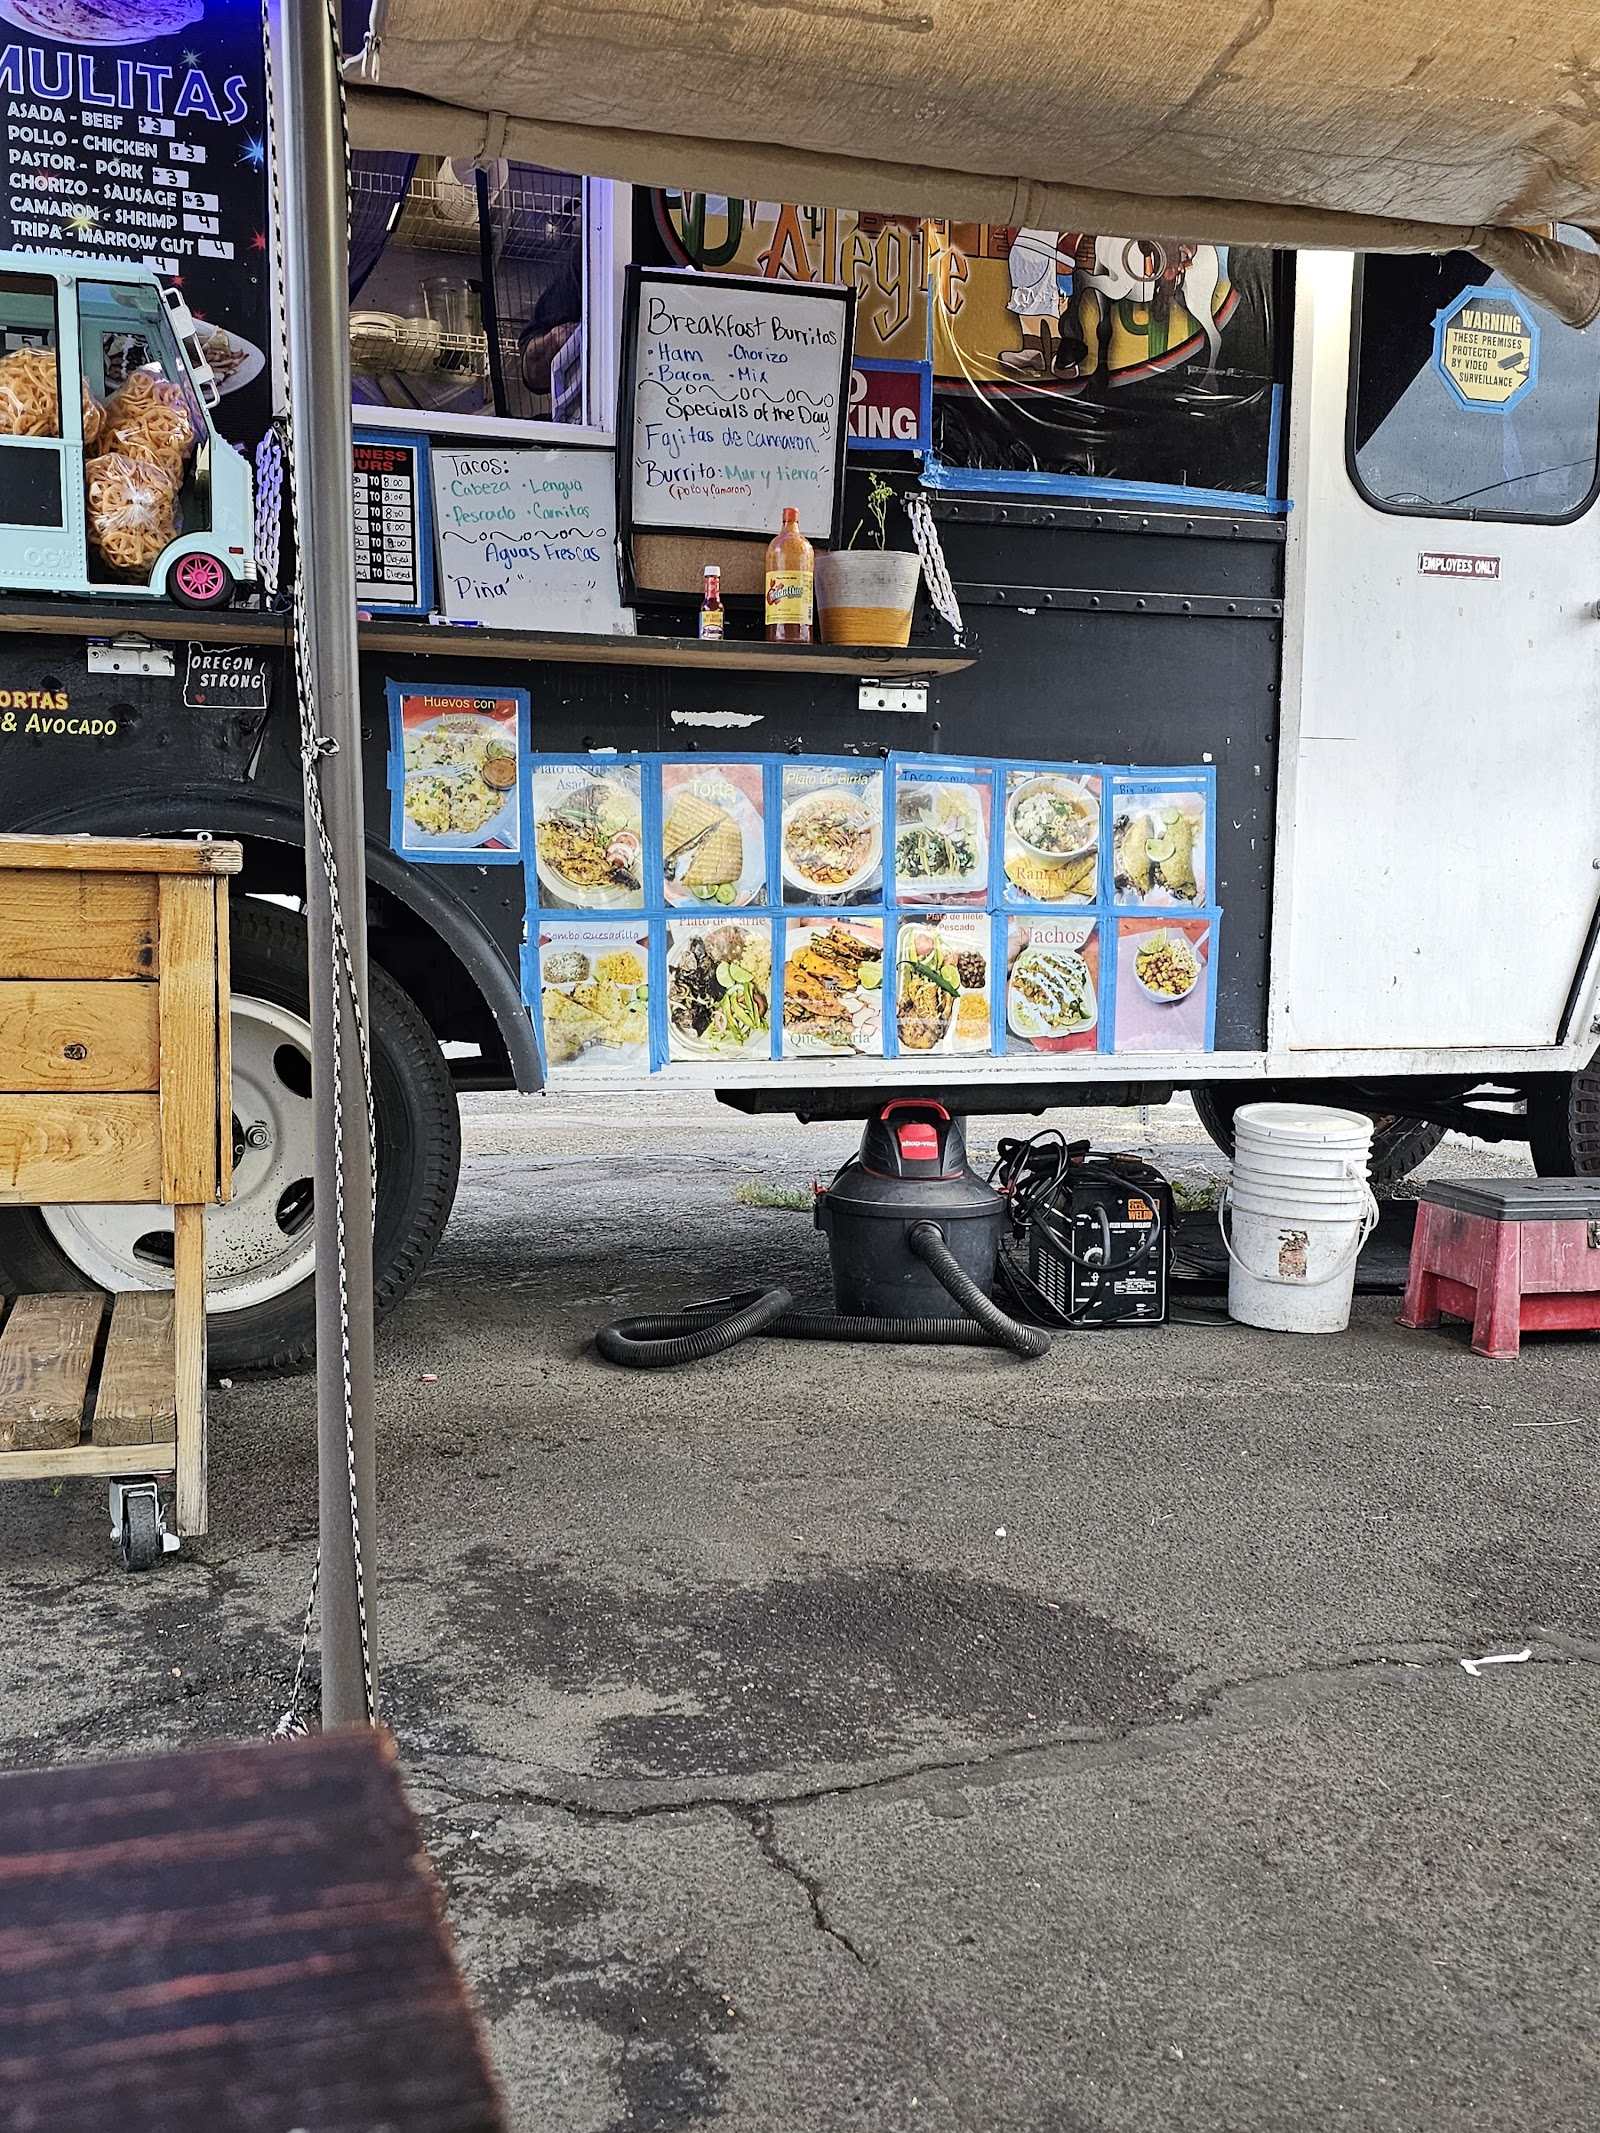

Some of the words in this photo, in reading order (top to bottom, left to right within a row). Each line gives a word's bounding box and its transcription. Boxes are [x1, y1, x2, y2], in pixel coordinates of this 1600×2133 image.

[8, 101, 66, 123] ASADA
[81, 110, 123, 130] BEEF
[8, 124, 67, 147] POLLO
[83, 134, 158, 158] CHICKEN
[9, 148, 76, 172] PASTOR
[96, 159, 144, 180] PORK
[9, 172, 88, 197] CHORIZO
[104, 183, 177, 207] SAUSAGE
[10, 196, 99, 221] CAMARON
[115, 208, 178, 229] SHRIMP
[11, 219, 62, 240] TRIPA
[78, 227, 158, 250] MARROW
[160, 236, 195, 255] GUT
[647, 297, 766, 337] Breakfast
[771, 316, 837, 346] Burritos
[1461, 309, 1522, 334] WARNING
[1454, 332, 1478, 344] THESE
[1482, 335, 1522, 350] PREMISES
[658, 342, 704, 362] Ham
[1452, 345, 1497, 359] PROTECTED
[1451, 358, 1462, 369] BY
[1465, 359, 1488, 371] VIDEO
[658, 365, 715, 382] Bacon
[737, 367, 769, 383] Mix
[1459, 372, 1513, 387] SURVEILLANCE
[665, 396, 748, 421] Specials
[753, 403, 769, 422] of
[772, 403, 795, 422] the
[799, 405, 831, 433] Day
[722, 427, 744, 447] de
[353, 449, 407, 461] INESS
[353, 460, 394, 471] URS
[441, 455, 510, 477] Tacos:
[369, 476, 380, 486] TO
[383, 476, 403, 487] 8:00
[761, 470, 773, 488] y
[369, 491, 380, 501] TO
[384, 492, 404, 501] 8:00
[451, 480, 511, 497] Cabeza
[529, 478, 583, 500] Lengua
[370, 506, 381, 517] TO
[453, 505, 516, 527] Pescado
[533, 502, 590, 520] Carnitas
[370, 522, 381, 532] TO
[371, 537, 382, 547] TO
[371, 552, 382, 562] TO
[485, 542, 540, 570] Aguas
[544, 543, 600, 562] Frescas
[372, 567, 383, 578] TO
[1422, 556, 1473, 573] EMPLOYEES
[1475, 560, 1498, 575] ONLY
[191, 656, 254, 670] OREGON
[200, 673, 262, 689] STRONG
[0, 690, 70, 712] ORTAS
[424, 696, 470, 708] Huevos
[473, 699, 496, 709] con
[2, 711, 18, 732] &
[786, 773, 815, 784] Plato
[820, 774, 834, 785] de
[838, 774, 868, 786] Birria
[902, 769, 933, 782] TACO
[689, 778, 737, 798] Torta
[1016, 867, 1066, 880] Ramen
[679, 914, 710, 926] Plato
[713, 915, 727, 926] de
[731, 916, 766, 926] Carne
[940, 923, 976, 931] Pescado
[545, 930, 580, 940] Combo
[582, 929, 640, 940] Quesadilla
[1020, 926, 1085, 943] Nachos
